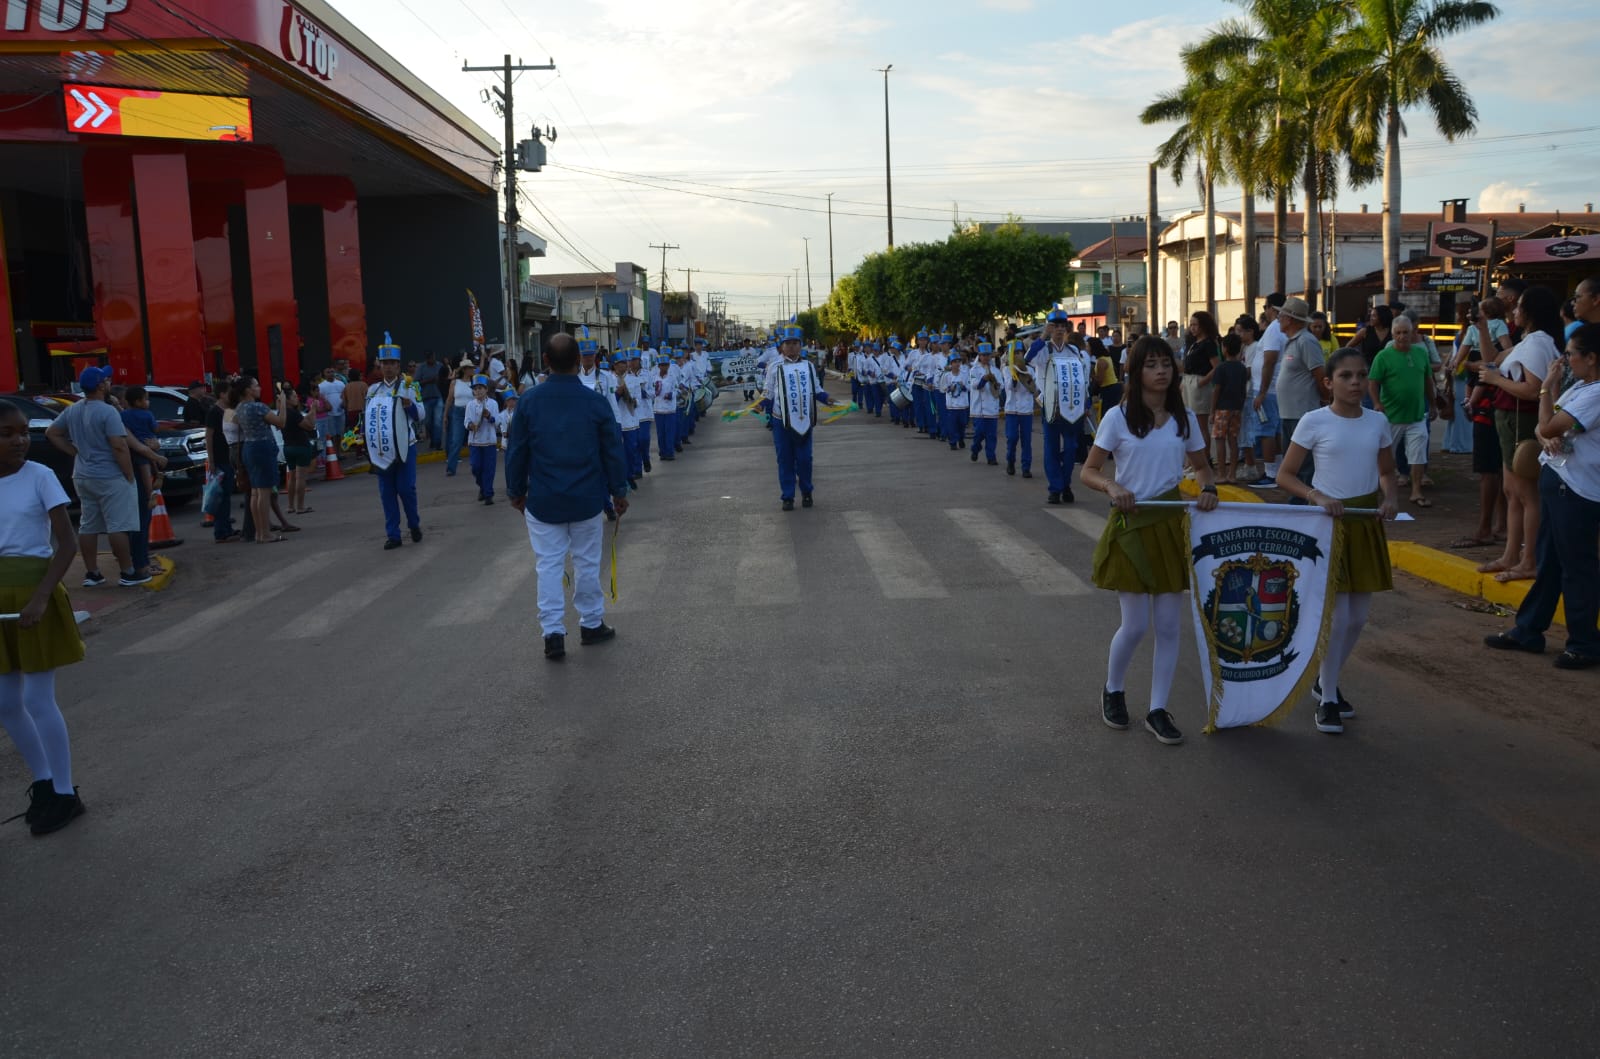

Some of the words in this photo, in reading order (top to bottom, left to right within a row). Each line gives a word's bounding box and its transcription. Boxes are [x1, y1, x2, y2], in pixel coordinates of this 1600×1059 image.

[303, 28, 339, 80] TOP
[728, 366, 758, 374] HISTO
[729, 359, 755, 367] ORIG
[788, 373, 798, 413] ESCOLA
[1061, 364, 1069, 403] ESCOLA
[369, 407, 378, 449] ESCOLA
[380, 405, 390, 452] OSVALDO
[1210, 528, 1263, 545] FANFARRA
[1265, 528, 1307, 546] ESCOLAR
[1219, 543, 1242, 556] ECOS
[1243, 541, 1256, 551] DO
[1258, 542, 1300, 557] CERRADO
